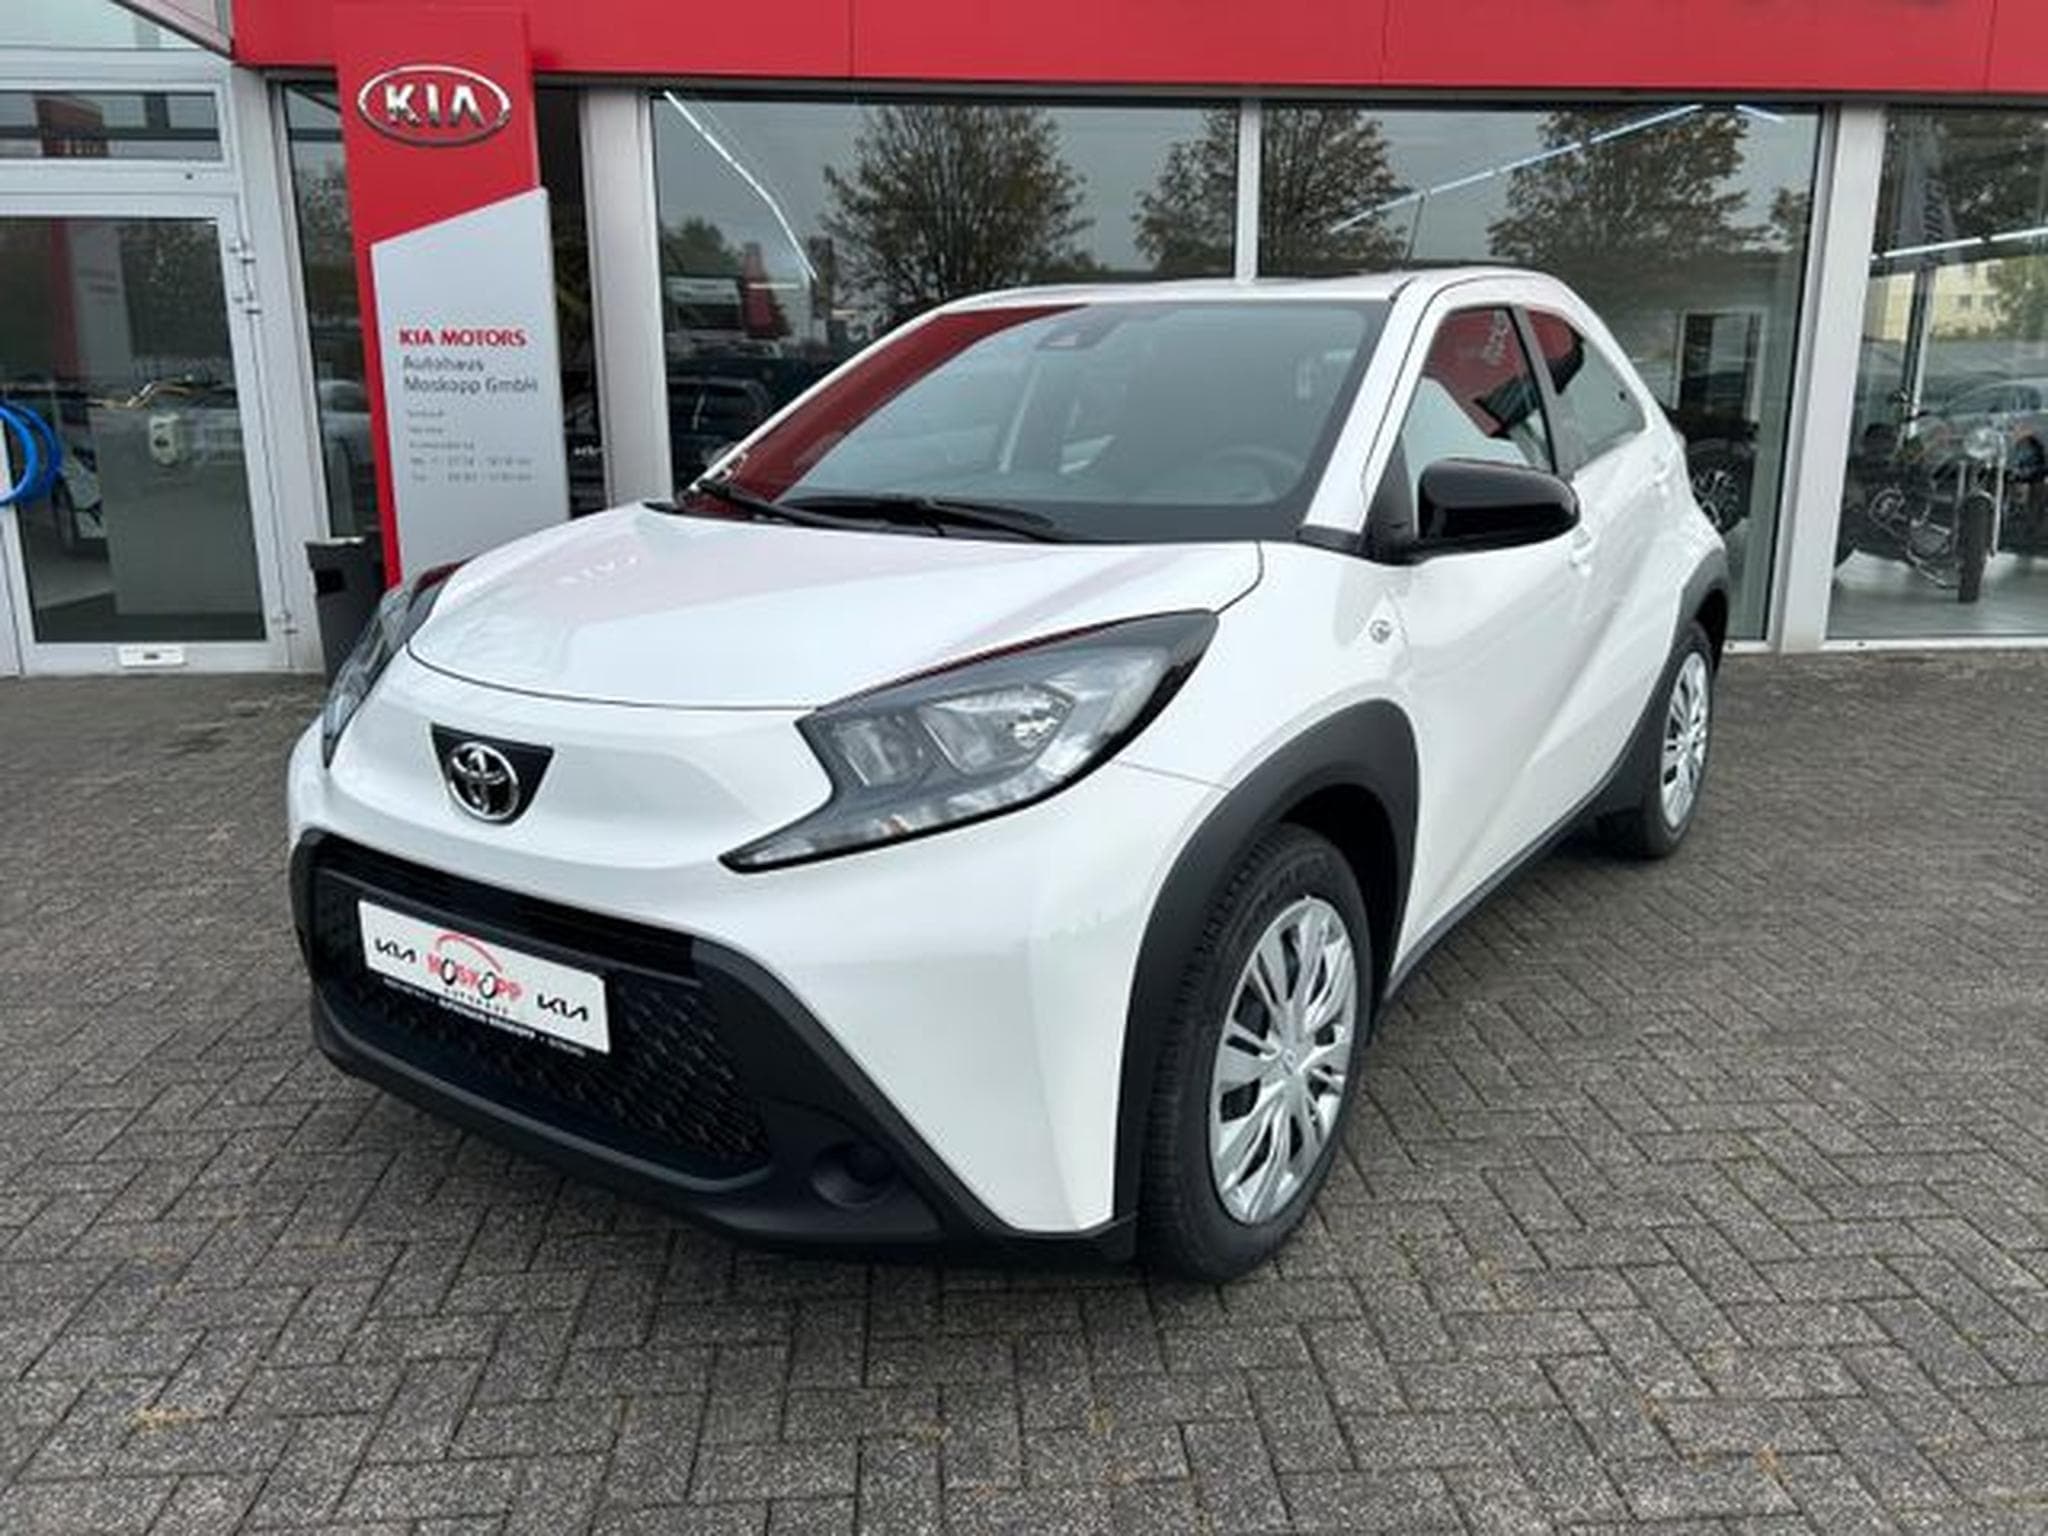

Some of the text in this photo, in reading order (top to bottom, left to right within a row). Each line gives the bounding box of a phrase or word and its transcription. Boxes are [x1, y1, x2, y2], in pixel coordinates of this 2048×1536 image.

[385, 83, 487, 127] KIA
[399, 328, 527, 347] KIA MOTORS
[403, 354, 485, 372] Autohaus
[485, 376, 539, 394] GmbH
